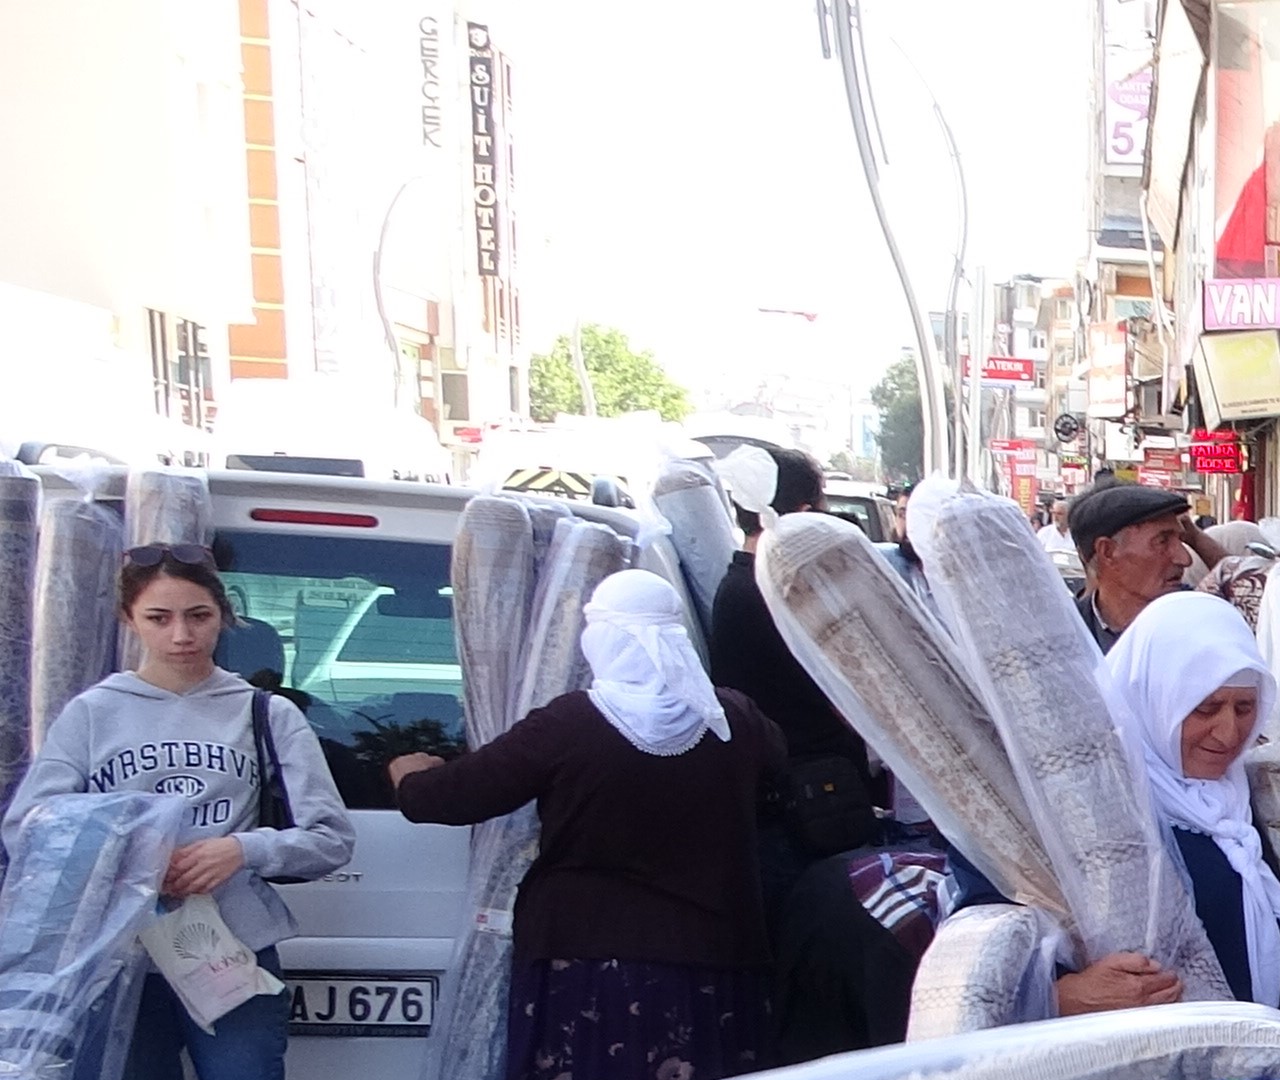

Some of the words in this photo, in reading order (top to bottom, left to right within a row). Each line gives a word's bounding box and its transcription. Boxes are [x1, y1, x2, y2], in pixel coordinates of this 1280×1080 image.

[471, 64, 493, 157] SUİT
[474, 163, 497, 271] HOTEL
[1209, 283, 1278, 325] VAN
[348, 985, 423, 1022] 676
